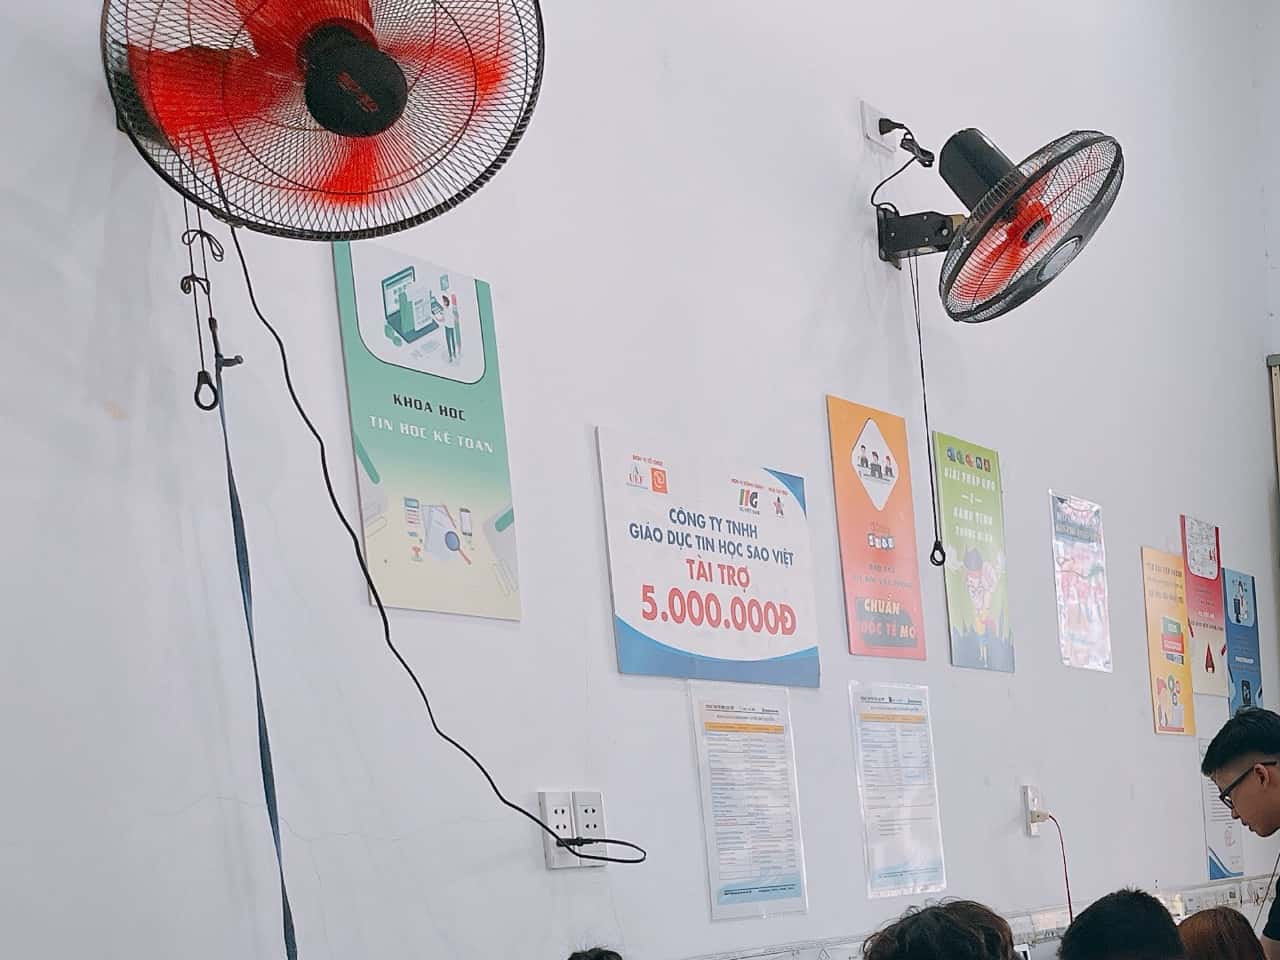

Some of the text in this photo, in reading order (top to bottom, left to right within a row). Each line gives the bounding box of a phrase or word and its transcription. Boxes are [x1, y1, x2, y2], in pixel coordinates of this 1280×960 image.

[369, 415, 393, 431] TIN
[668, 506, 758, 539] CÔNG TY TNHH
[629, 520, 794, 568] GIÁO DỤC TIN HỌC SAO VIỆT
[685, 554, 751, 593] TÀI TRỢ
[640, 583, 797, 637] 5.000.000Đ
